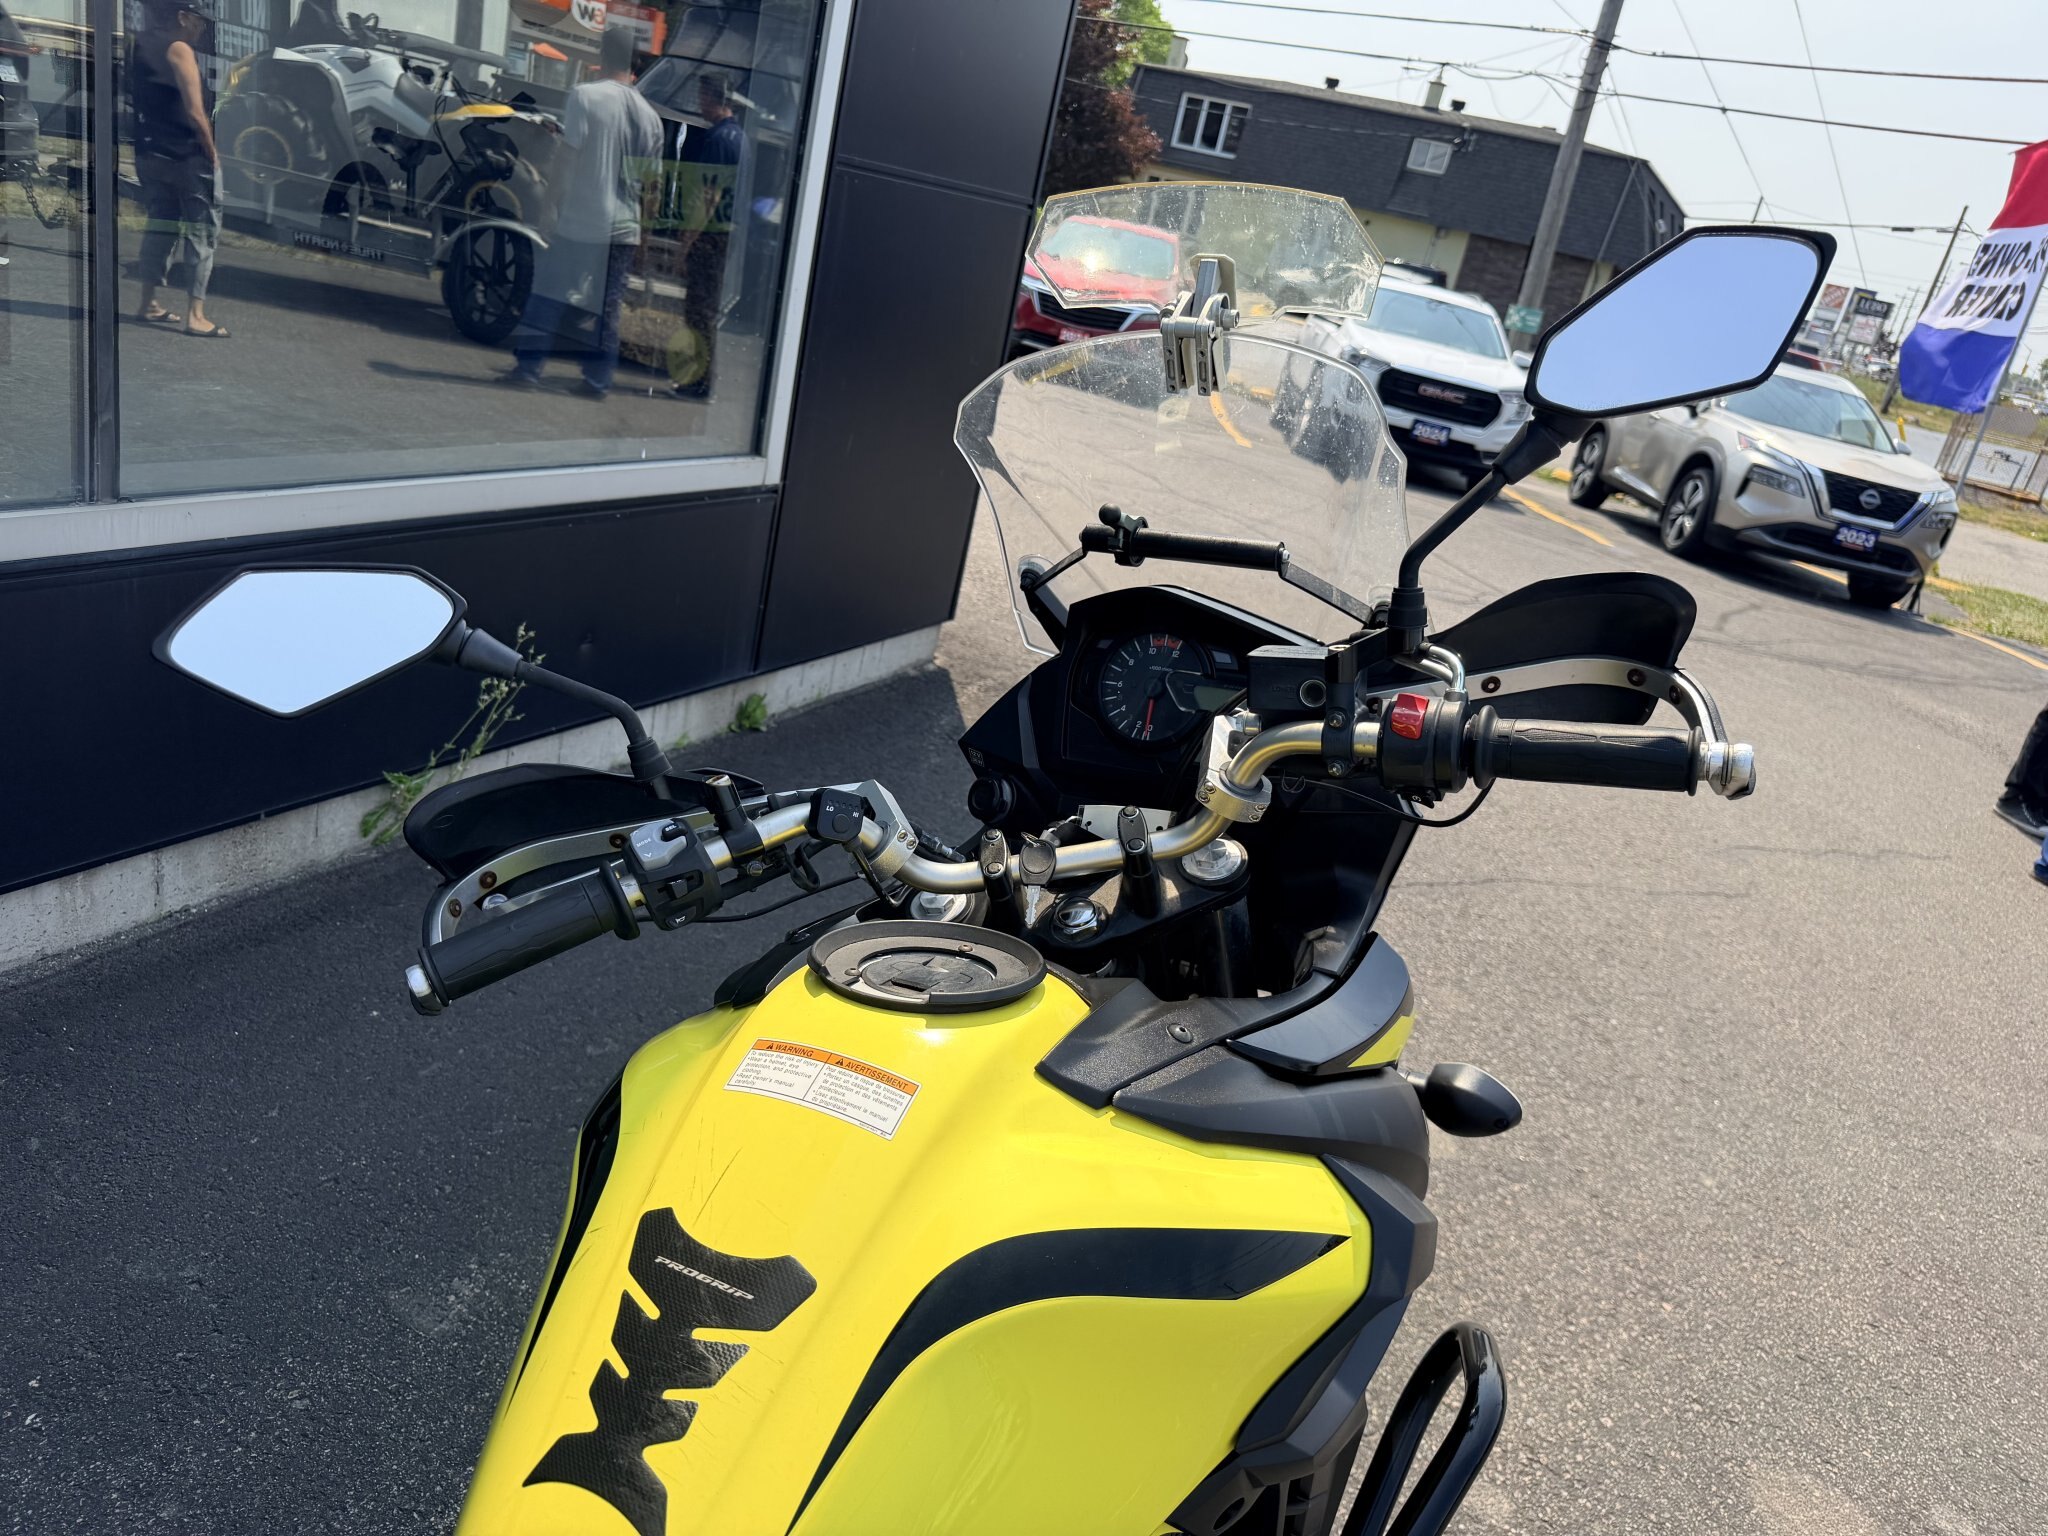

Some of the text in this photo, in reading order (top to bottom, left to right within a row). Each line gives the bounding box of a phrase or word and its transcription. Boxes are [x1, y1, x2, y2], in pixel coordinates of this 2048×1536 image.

[1417, 382, 1468, 405] GMC
[1411, 422, 1448, 440] 2024
[1836, 527, 1876, 548] 2023
[1172, 650, 1180, 658] 12
[1128, 658, 1135, 666] 8
[1117, 680, 1123, 688] 6
[1120, 704, 1127, 712] 4
[1136, 720, 1142, 728] 2
[665, 824, 677, 832] SEL
[636, 838, 652, 847] MODE
[775, 1043, 814, 1057] WARNING
[784, 1068, 812, 1079] protective
[826, 1065, 836, 1073] Pour
[859, 1076, 874, 1087] risque
[845, 1061, 908, 1090] AVERTISSEMENT
[774, 1079, 795, 1088] manual
[829, 1081, 854, 1094] protection
[861, 1091, 871, 1100] des
[872, 1095, 898, 1112] vêtements
[871, 1088, 882, 1096] des
[882, 1093, 904, 1107] lunettes
[829, 1095, 862, 1112] attentivement
[868, 1110, 889, 1122] manuel
[654, 1255, 755, 1300] PROGRIP
